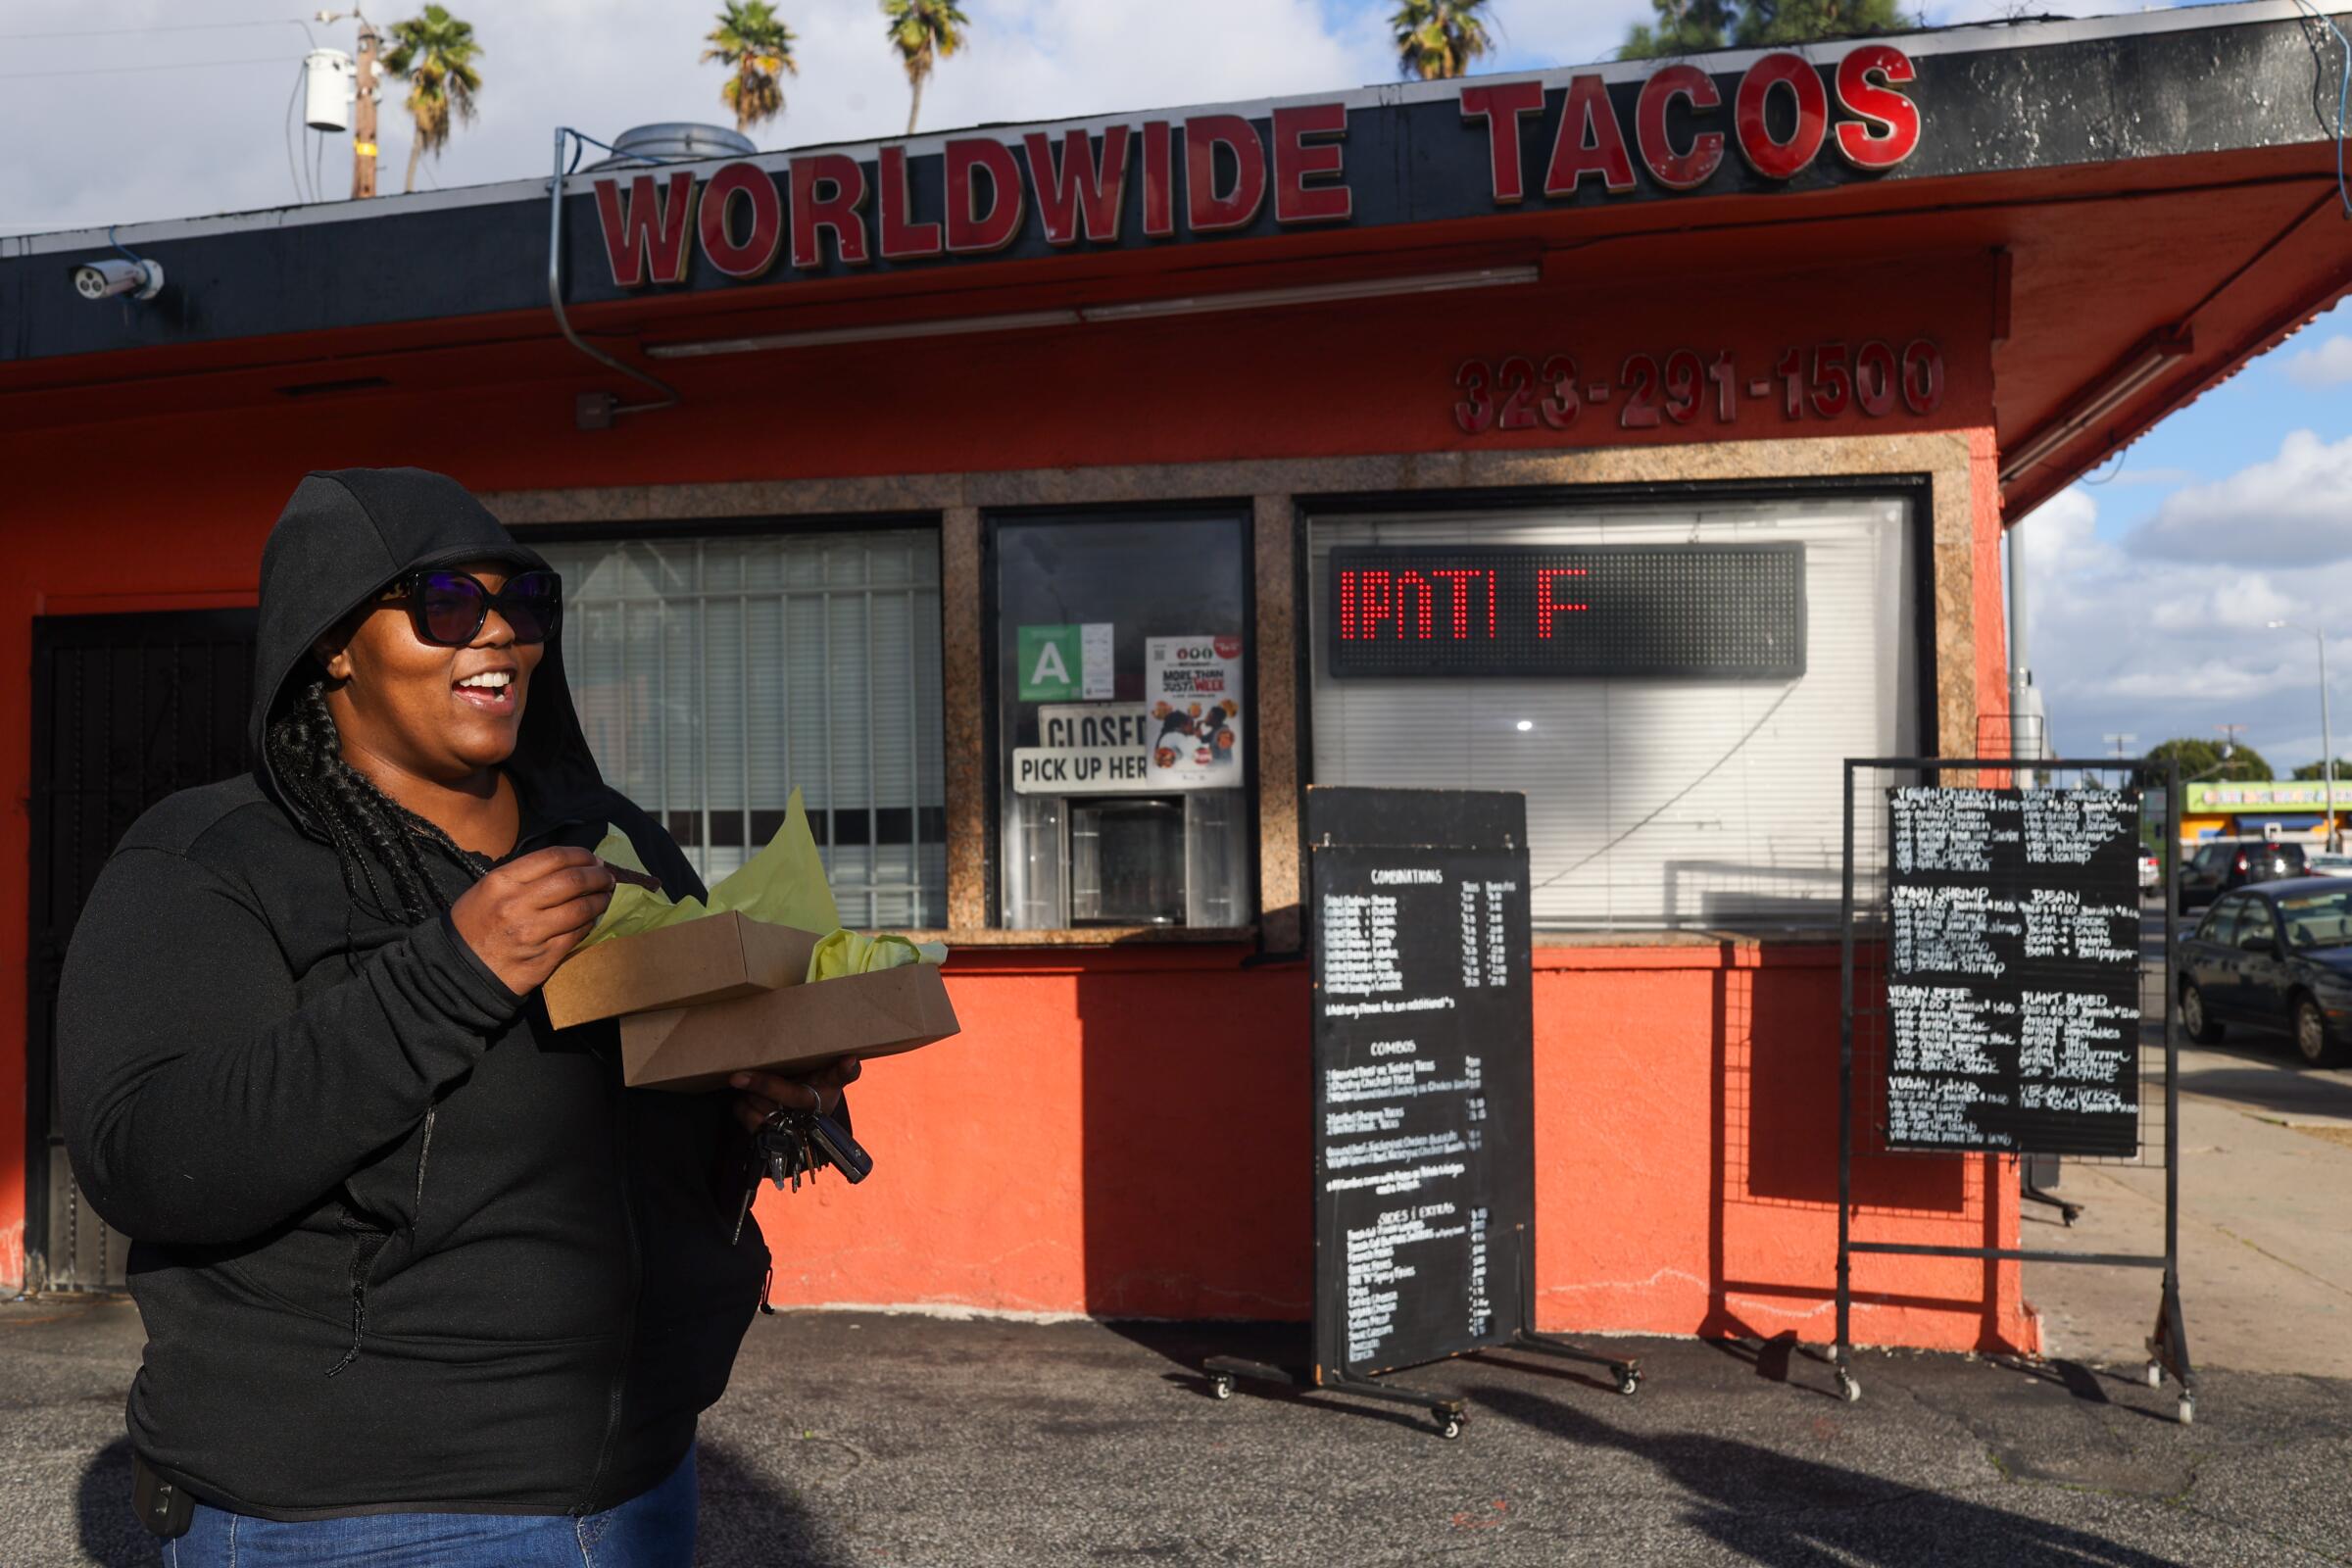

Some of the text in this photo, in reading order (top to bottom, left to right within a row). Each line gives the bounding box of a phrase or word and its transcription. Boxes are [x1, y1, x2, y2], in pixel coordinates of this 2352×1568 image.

[593, 43, 1922, 288] WORLDWIDE TACOS
[1454, 338, 1944, 433] 323-291-1500
[1030, 641, 1071, 685] A
[1163, 669, 1224, 681] MORE THAN
[1163, 681, 1188, 692] JUST
[1022, 756, 1147, 782] PICK UP HER
[1891, 886, 1989, 902] VEGAN SHRIMP
[2031, 889, 2081, 905] BEAN
[1888, 985, 1973, 1002] VEGAN BEEF
[2022, 991, 2108, 1006] PLANT BASED
[1370, 1040, 1416, 1056] COMBOS
[1888, 1076, 1980, 1095] VEGAN LAMB
[2020, 1084, 2067, 1099] VEGAN
[1378, 1201, 1456, 1225] SIDES EXTRAS
